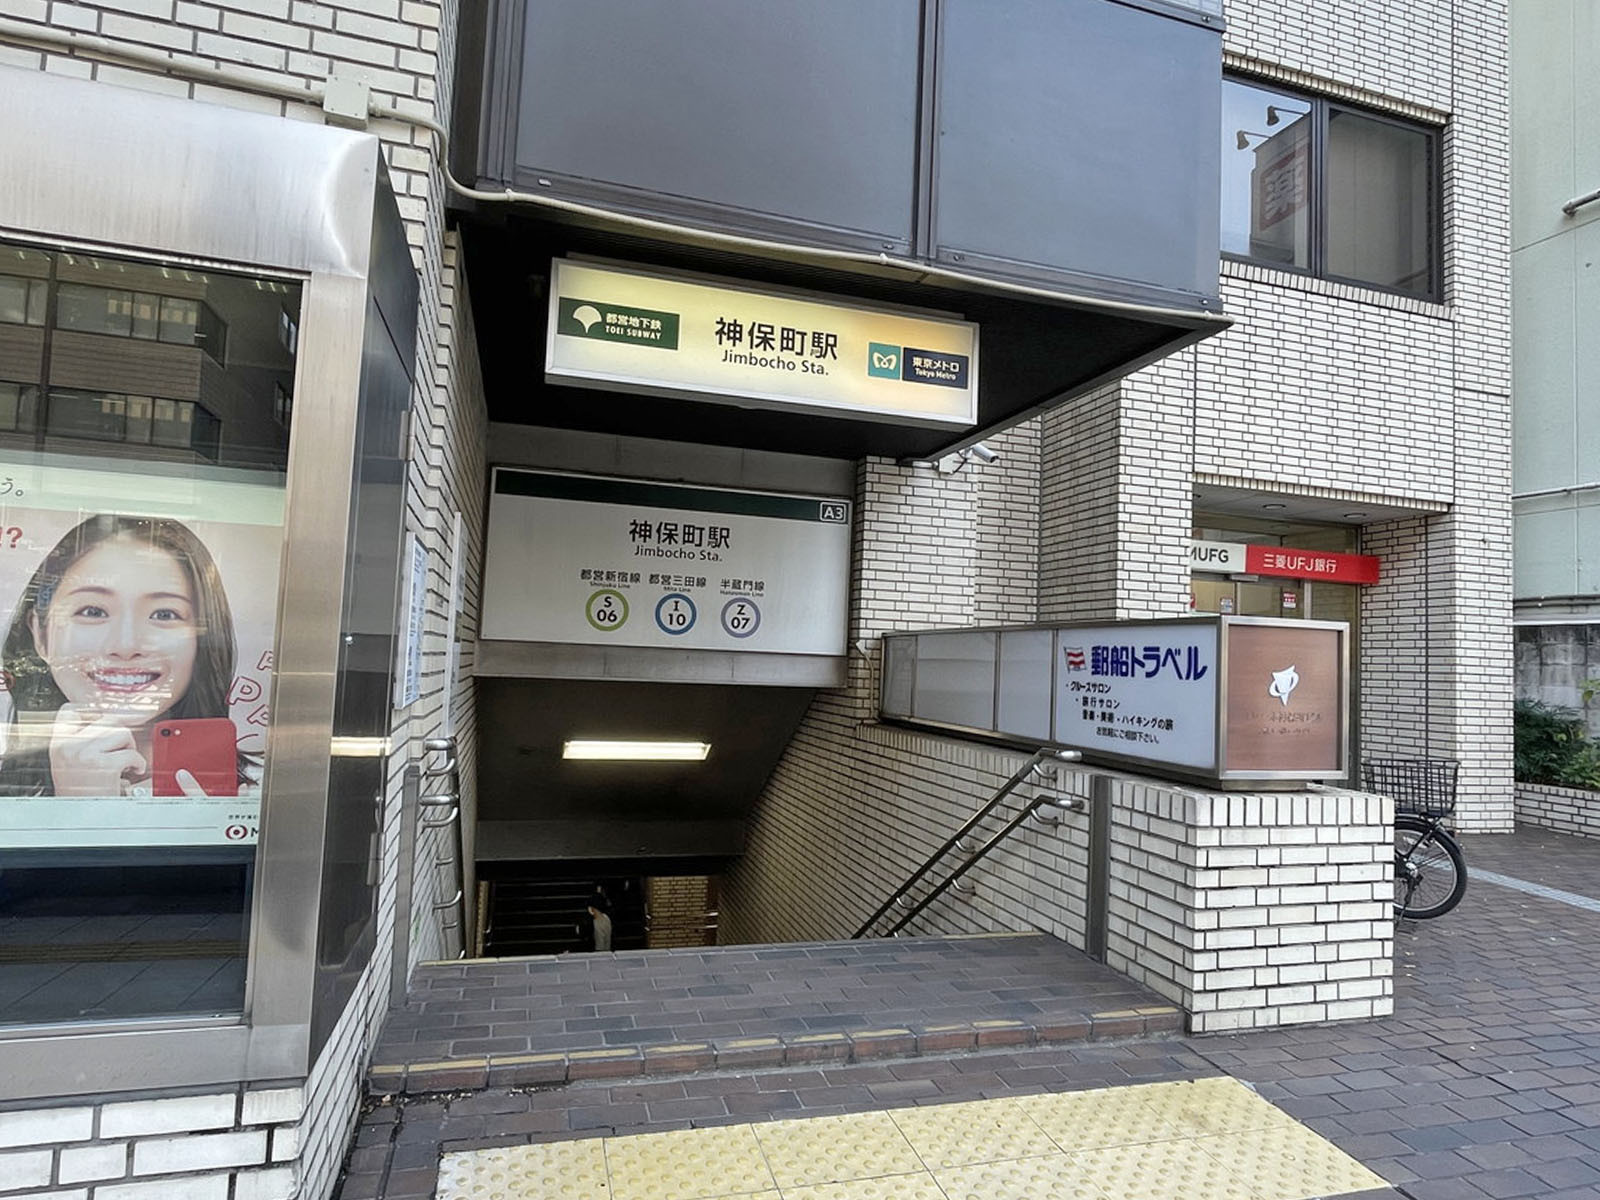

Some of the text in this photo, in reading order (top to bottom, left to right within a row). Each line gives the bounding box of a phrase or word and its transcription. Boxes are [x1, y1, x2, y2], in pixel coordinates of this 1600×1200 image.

[605, 313, 662, 330] 都営地下鉄
[605, 325, 662, 340] TOEI SUBWAY
[715, 317, 837, 360] 神保町駅
[722, 349, 829, 376] Jimbocho Sta.
[912, 356, 960, 373] 東京メトロ
[915, 367, 956, 380] Tokyo Metro
[824, 506, 844, 519] A3
[629, 519, 730, 549] 神保町駅
[634, 545, 723, 562] Jimbocho Sta.
[1263, 553, 1337, 573] 三菱UFJ銀行
[580, 569, 641, 583] 都営新宿線
[648, 573, 707, 588] 都営三田線
[720, 578, 765, 592] 半蔵門線
[604, 596, 612, 608] S
[673, 600, 680, 612] I
[596, 609, 617, 622] 06
[737, 604, 746, 615] Z
[668, 613, 686, 626] 10
[731, 617, 751, 629] 07
[1091, 645, 1208, 681] 郵船トラベル
